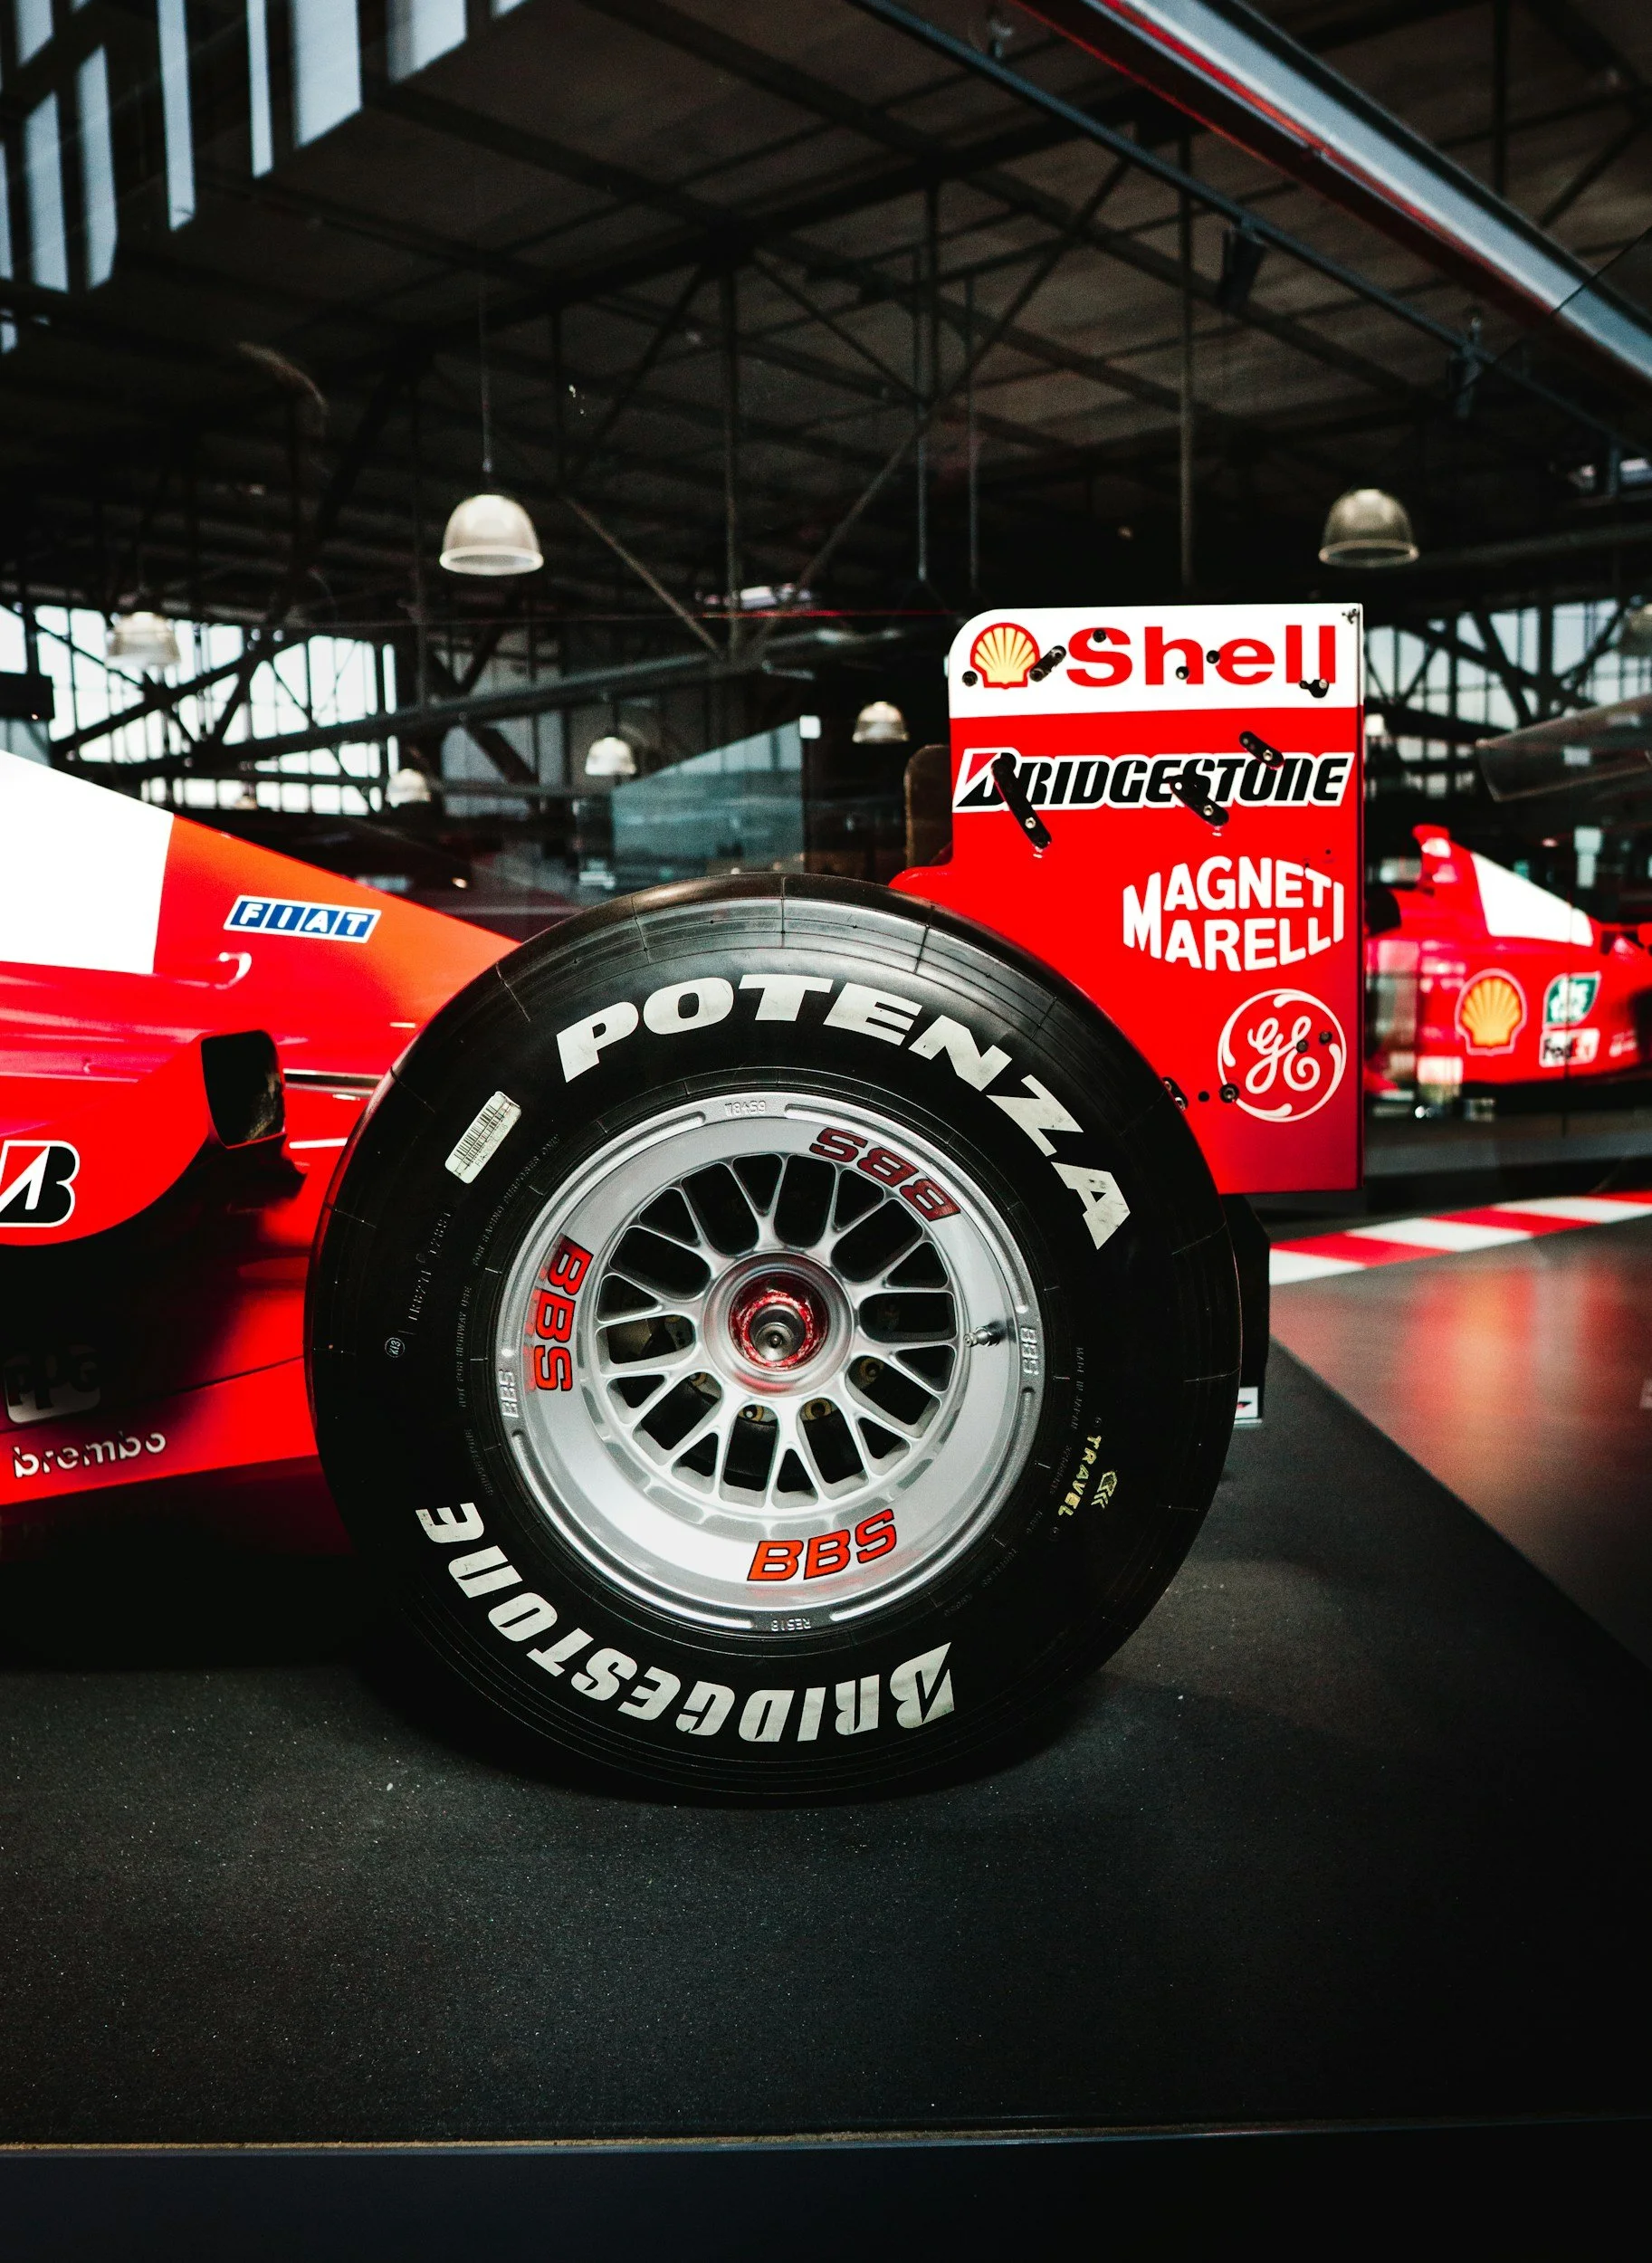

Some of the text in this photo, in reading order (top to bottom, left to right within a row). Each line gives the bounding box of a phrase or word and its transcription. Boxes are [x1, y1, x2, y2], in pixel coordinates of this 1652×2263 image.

[1067, 625, 1336, 688] Shell
[952, 748, 1355, 813] BRIDGESTONE
[239, 902, 369, 936] FIAT
[1123, 856, 1344, 941] MAGNETI
[1123, 887, 1344, 971] MARELLI
[556, 973, 1131, 1250] POTENZA
[808, 1127, 961, 1222] BBS
[534, 1236, 595, 1392] BBS
[498, 1370, 520, 1418] BBS
[14, 1430, 167, 1478] brembo
[1057, 1435, 1103, 1516] TRAVEL
[747, 1508, 898, 1582] BBS
[415, 1502, 956, 1743] BRIDGESTONE
